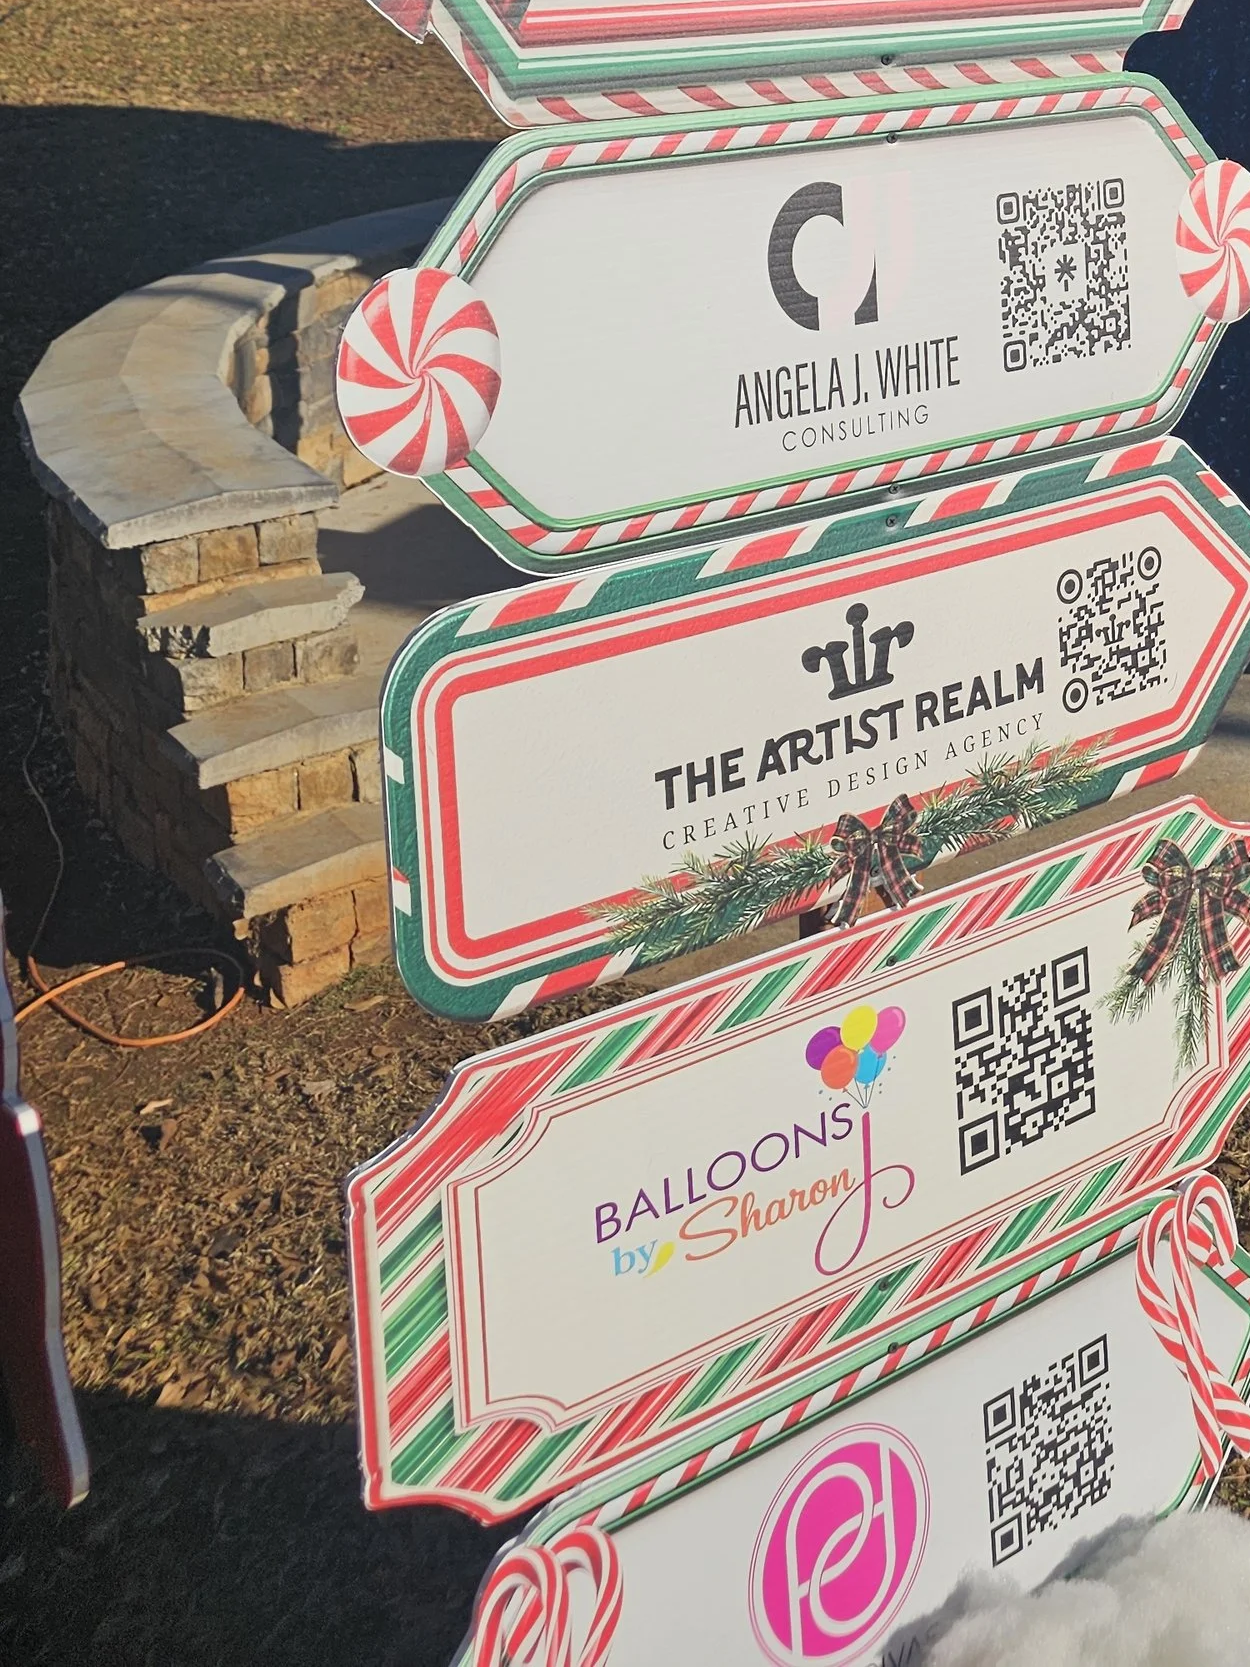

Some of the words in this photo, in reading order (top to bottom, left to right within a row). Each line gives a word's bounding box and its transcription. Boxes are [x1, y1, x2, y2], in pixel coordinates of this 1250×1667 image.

[734, 356, 846, 429] ANGELA
[852, 352, 870, 406] J.
[875, 335, 961, 401] WHITE
[782, 404, 930, 452] CONSULTING
[654, 747, 746, 810] THE
[756, 699, 905, 783] ARTIST
[915, 656, 1045, 733] REALM
[662, 787, 811, 851] CREATIVE
[827, 748, 929, 799] DESIGN
[944, 712, 1045, 762] AGENCY
[595, 1102, 854, 1244] BALLOONS
[611, 1238, 659, 1278] by
[678, 1167, 857, 1263] Sharon
